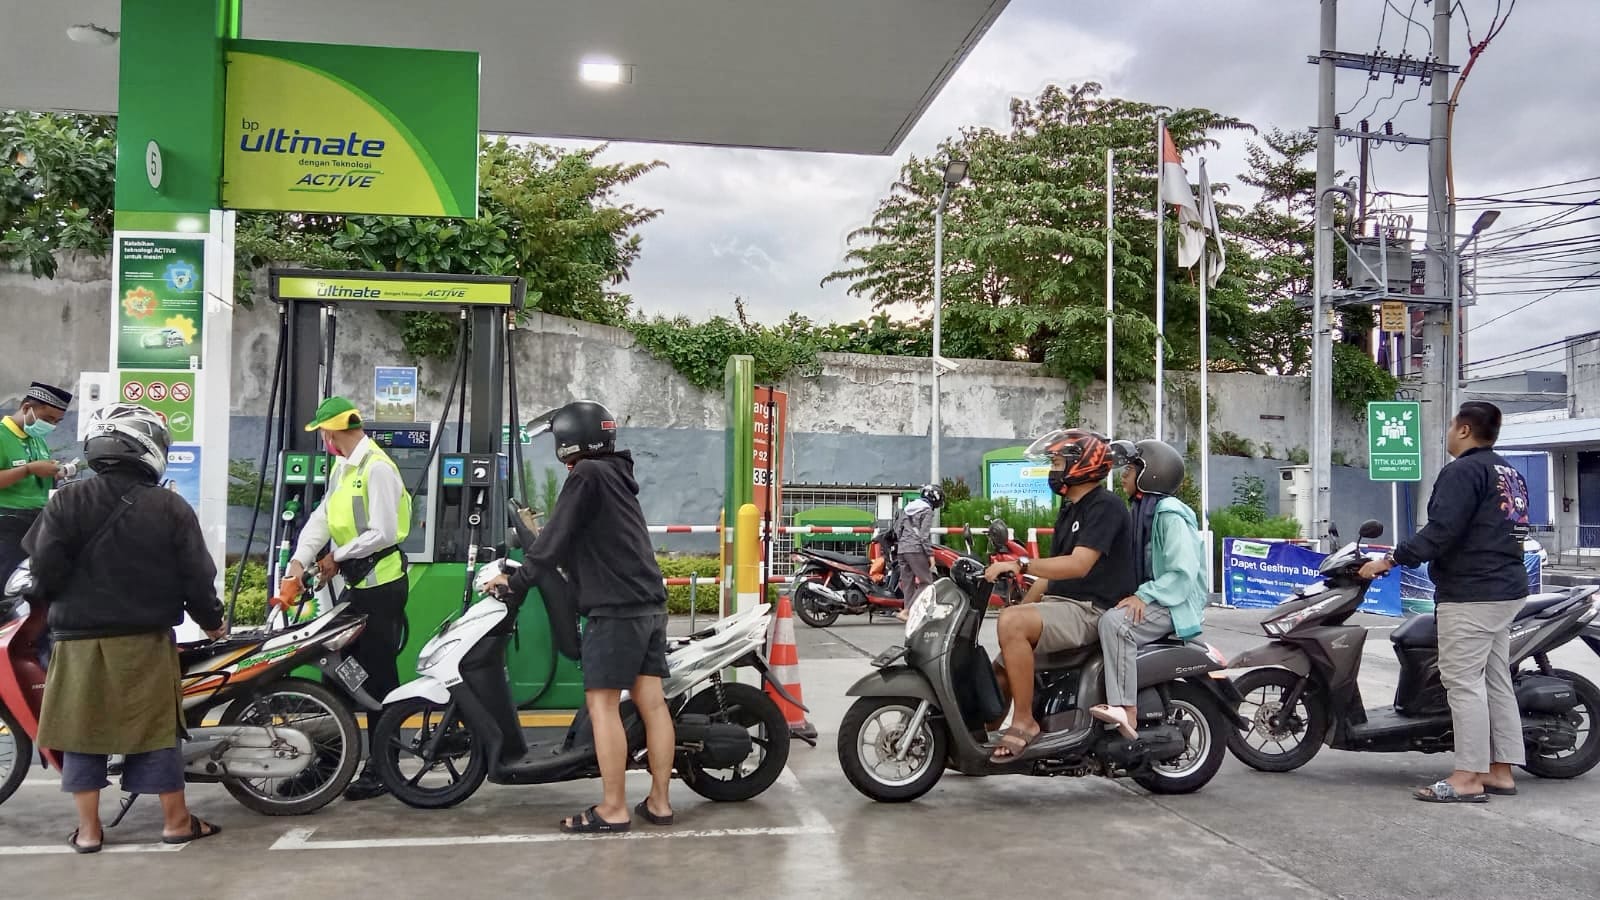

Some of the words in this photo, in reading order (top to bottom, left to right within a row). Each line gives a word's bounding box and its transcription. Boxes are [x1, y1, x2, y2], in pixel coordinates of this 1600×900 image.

[242, 117, 259, 131] bp
[240, 128, 385, 157] ultimate
[151, 151, 157, 176] 5
[299, 158, 330, 168] dengan
[332, 159, 372, 169] Teknologi
[296, 173, 376, 188] ACTIVE
[317, 285, 381, 298] ultimate
[424, 289, 465, 298] ACTIVE
[759, 451, 768, 462] 92
[1260, 562, 1299, 576] Gesitnya
[1302, 565, 1321, 578] Dap
